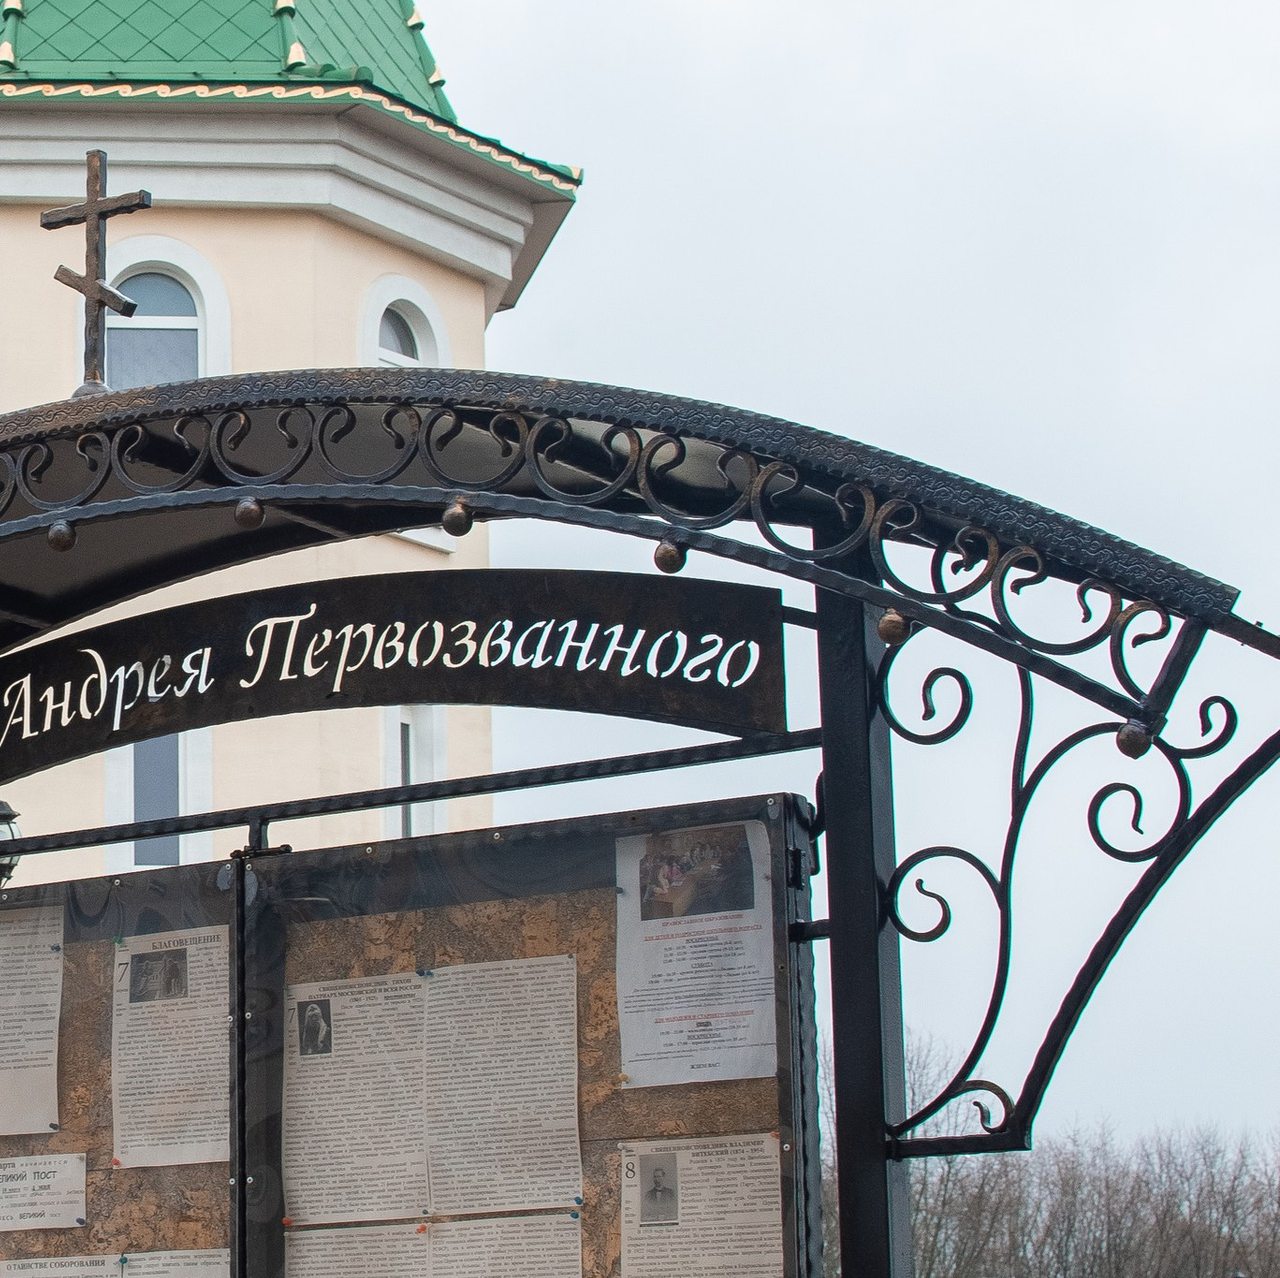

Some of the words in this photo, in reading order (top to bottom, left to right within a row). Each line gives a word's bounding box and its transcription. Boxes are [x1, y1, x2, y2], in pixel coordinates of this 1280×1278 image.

[239, 603, 760, 693] Первозванного
[151, 934, 222, 950] БЛАГОВЕЩЕНИЕ
[118, 962, 129, 982] 7
[288, 1007, 296, 1023] 7
[33, 1170, 58, 1181] ПОСТ
[625, 1161, 636, 1179] 8
[13, 1261, 48, 1271] ТАИНСТВЕ
[49, 1259, 106, 1269] СОБОРОВАНИЯ
